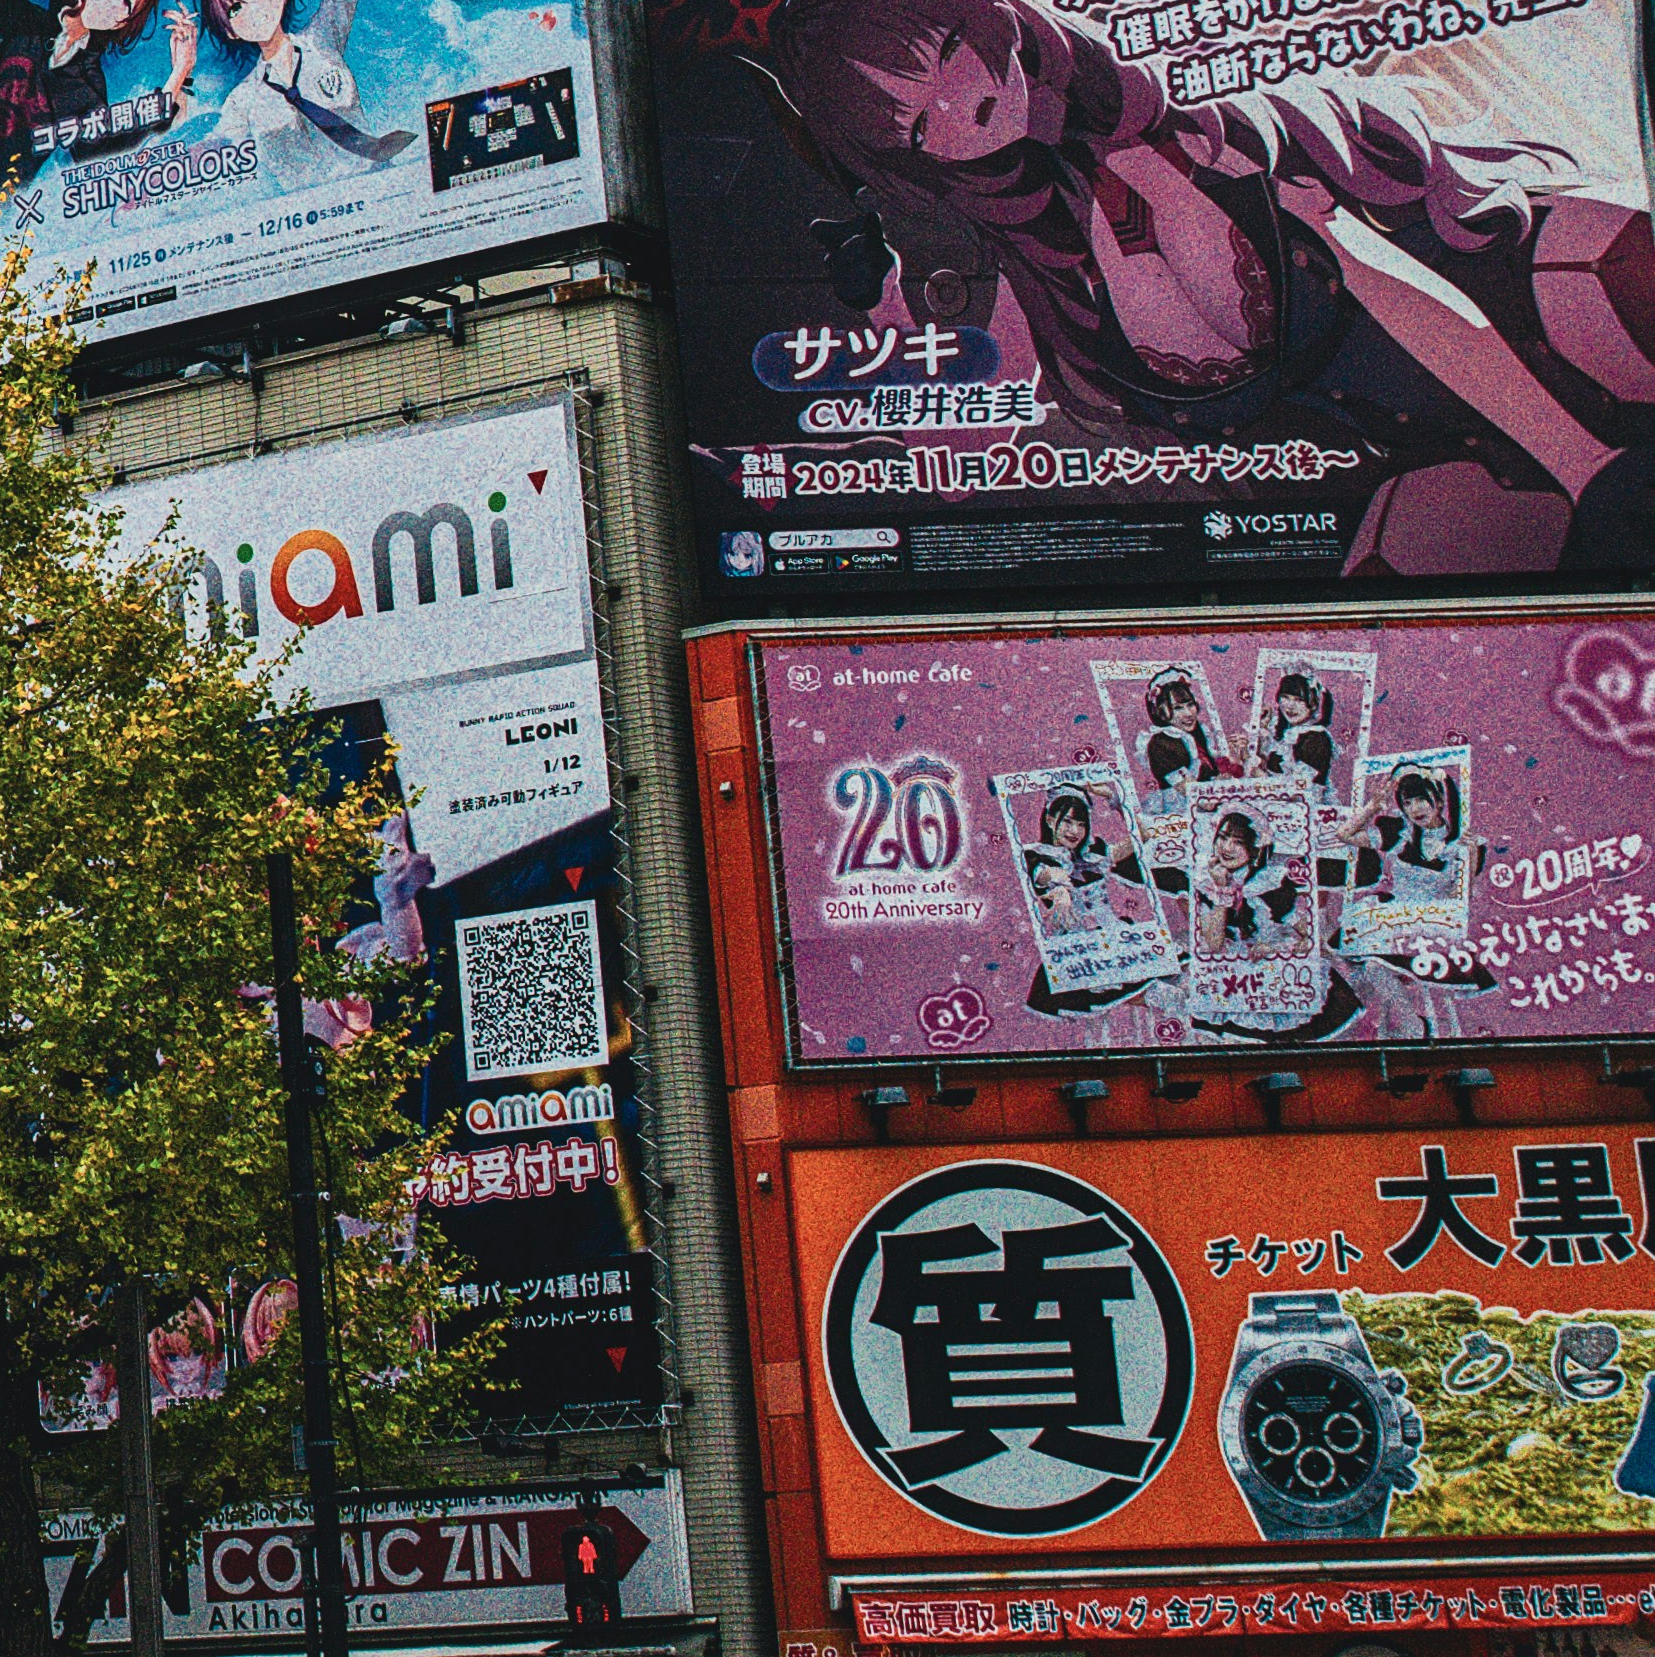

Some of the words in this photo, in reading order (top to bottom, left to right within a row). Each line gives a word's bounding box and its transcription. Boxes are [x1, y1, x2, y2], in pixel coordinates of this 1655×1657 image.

[109, 250, 151, 275] 11/25
[258, 212, 303, 238] 12/16
[783, 323, 961, 380] サツキ
[741, 452, 786, 476] 登場
[742, 476, 787, 499] 期間
[777, 531, 835, 549] ブルアカ
[1235, 511, 1338, 535] YOSTAR
[833, 667, 920, 686] at-home
[928, 665, 973, 683] cafe
[504, 717, 579, 747] LEONI
[543, 754, 582, 775] 1/12
[447, 779, 585, 816] 塗装済み可動フィギュア
[834, 763, 962, 877] 20
[922, 880, 956, 894] cafe
[825, 900, 869, 920] 20th
[874, 899, 984, 920] Anniversary
[468, 1084, 612, 1132] amiami
[1375, 1141, 1655, 1272] 大黒
[1203, 1231, 1364, 1279] チケット
[870, 1212, 1166, 1489] 質
[441, 1522, 533, 1584] ZIN
[861, 1599, 996, 1637] 高価買取
